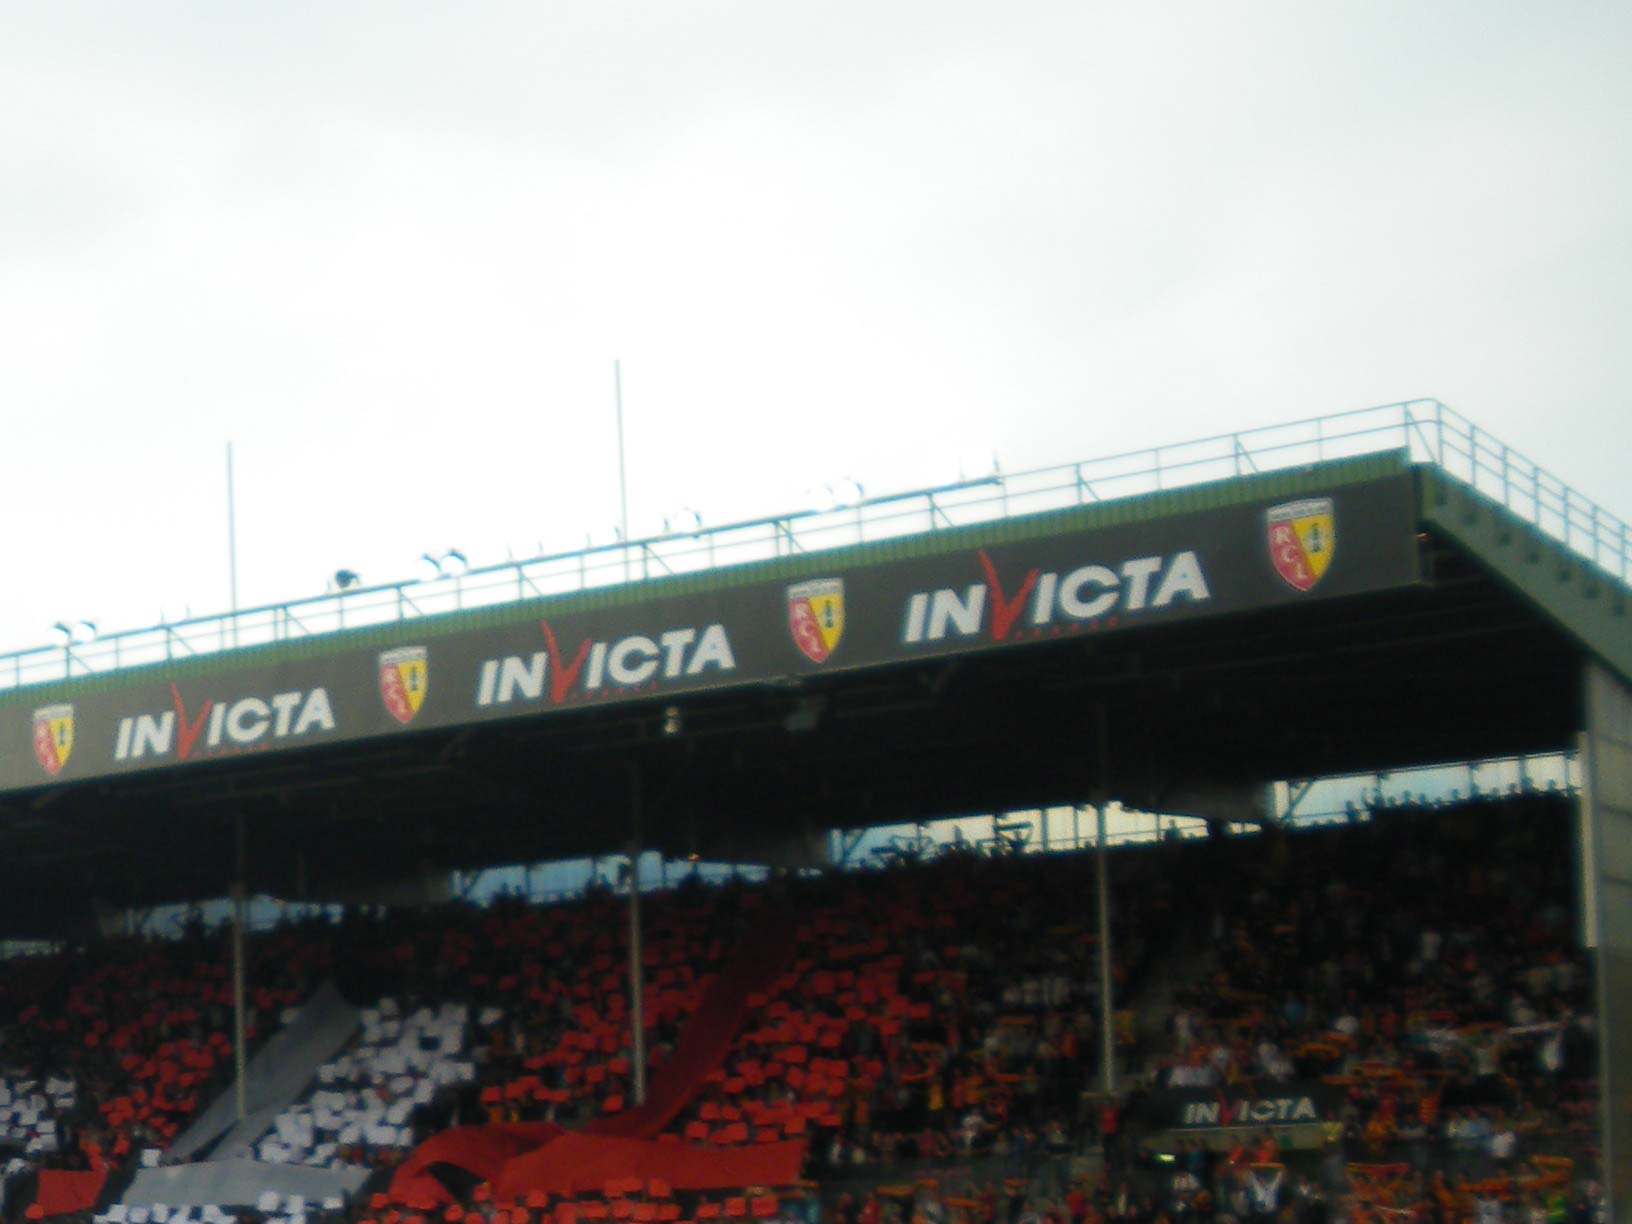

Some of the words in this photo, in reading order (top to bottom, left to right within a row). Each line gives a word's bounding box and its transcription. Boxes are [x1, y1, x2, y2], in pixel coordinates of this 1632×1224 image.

[901, 548, 1210, 643] INVICTA
[476, 619, 736, 704] INVICTA
[114, 682, 335, 760] INVICTA
[1185, 1092, 1316, 1126] INVICTA
